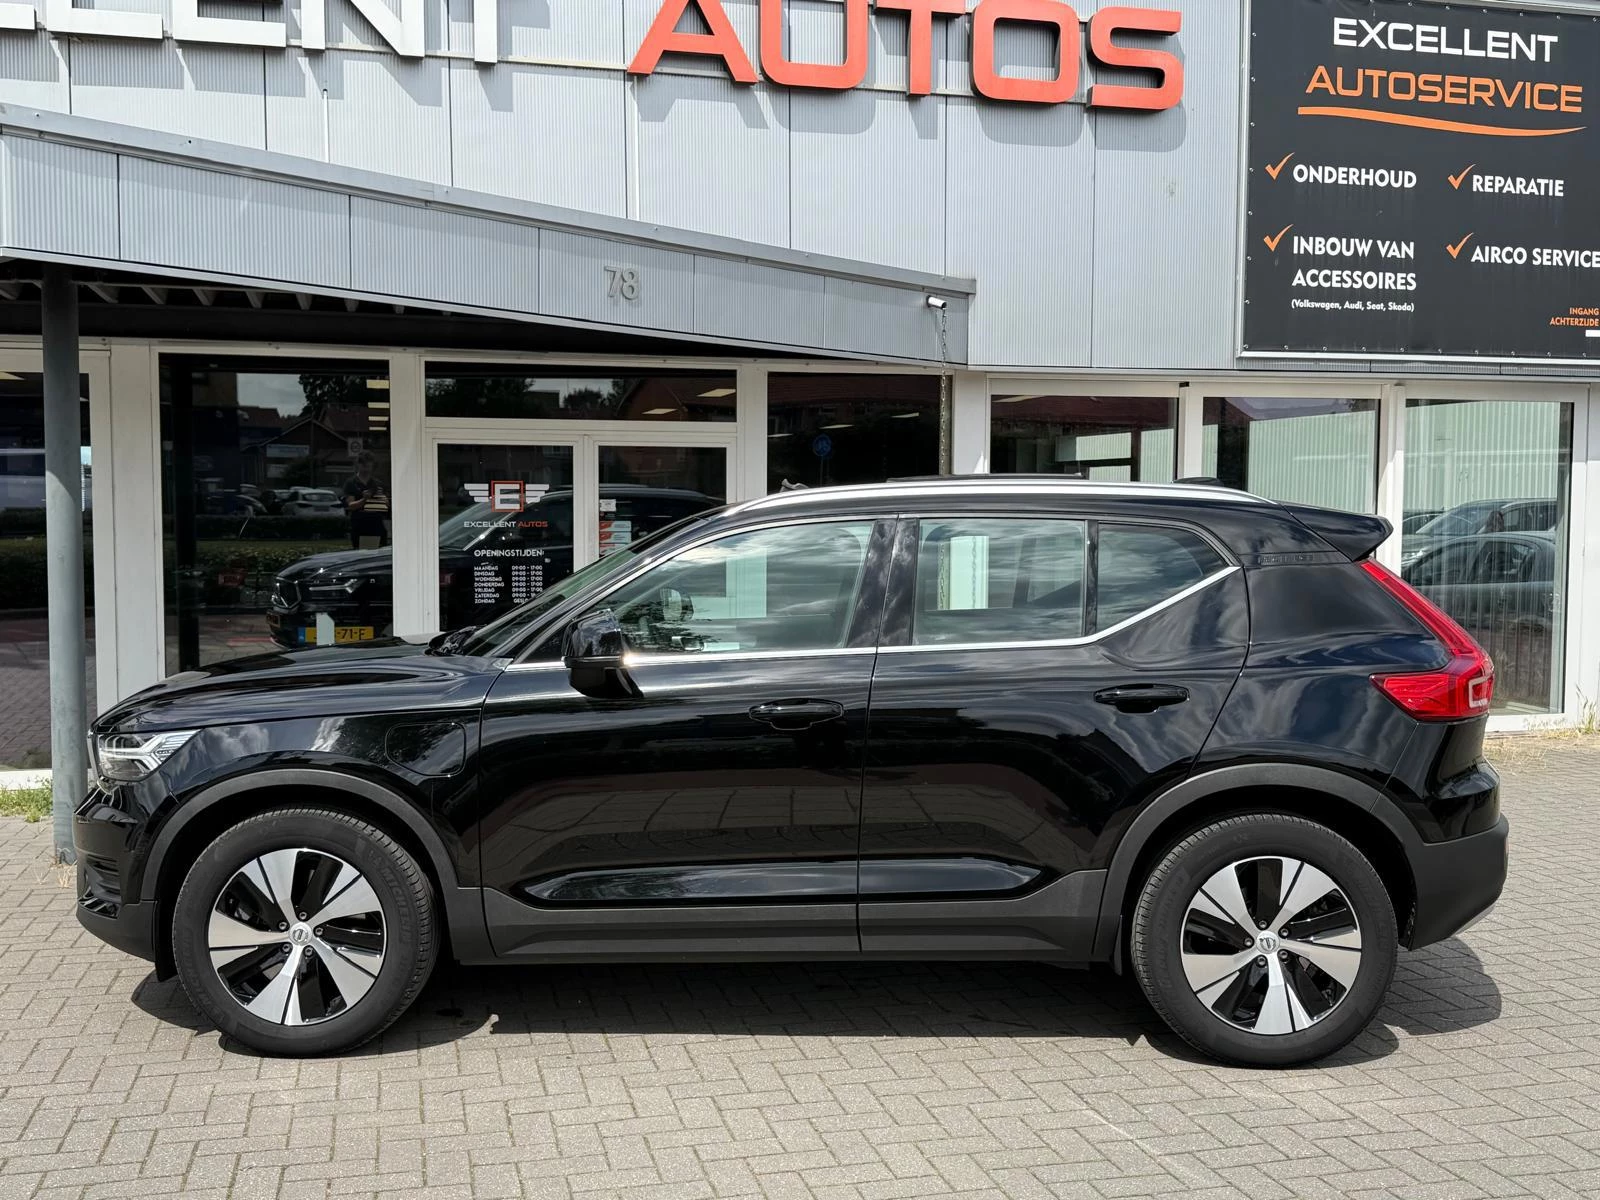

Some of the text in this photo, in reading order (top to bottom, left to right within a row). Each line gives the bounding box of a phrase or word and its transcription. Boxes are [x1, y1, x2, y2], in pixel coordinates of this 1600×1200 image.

[1333, 17, 1559, 62] EXCELLENT
[627, 0, 1184, 110] AUTOS
[1305, 65, 1583, 112] AUTOSERVICE
[1293, 164, 1417, 188] ONDERHOUD
[1472, 174, 1564, 196] REPARATIE
[1293, 236, 1414, 260] INBOUW VAN
[1471, 245, 1600, 268] AIRCO SERVICE
[604, 266, 639, 300] 78
[1292, 269, 1417, 290] ACCESSOIRES
[1291, 299, 1414, 312] (Volkswagen, Audi, Seat, Skoda)
[1569, 307, 1599, 316] INGANG
[1549, 317, 1600, 327] ACHTERZIJDE
